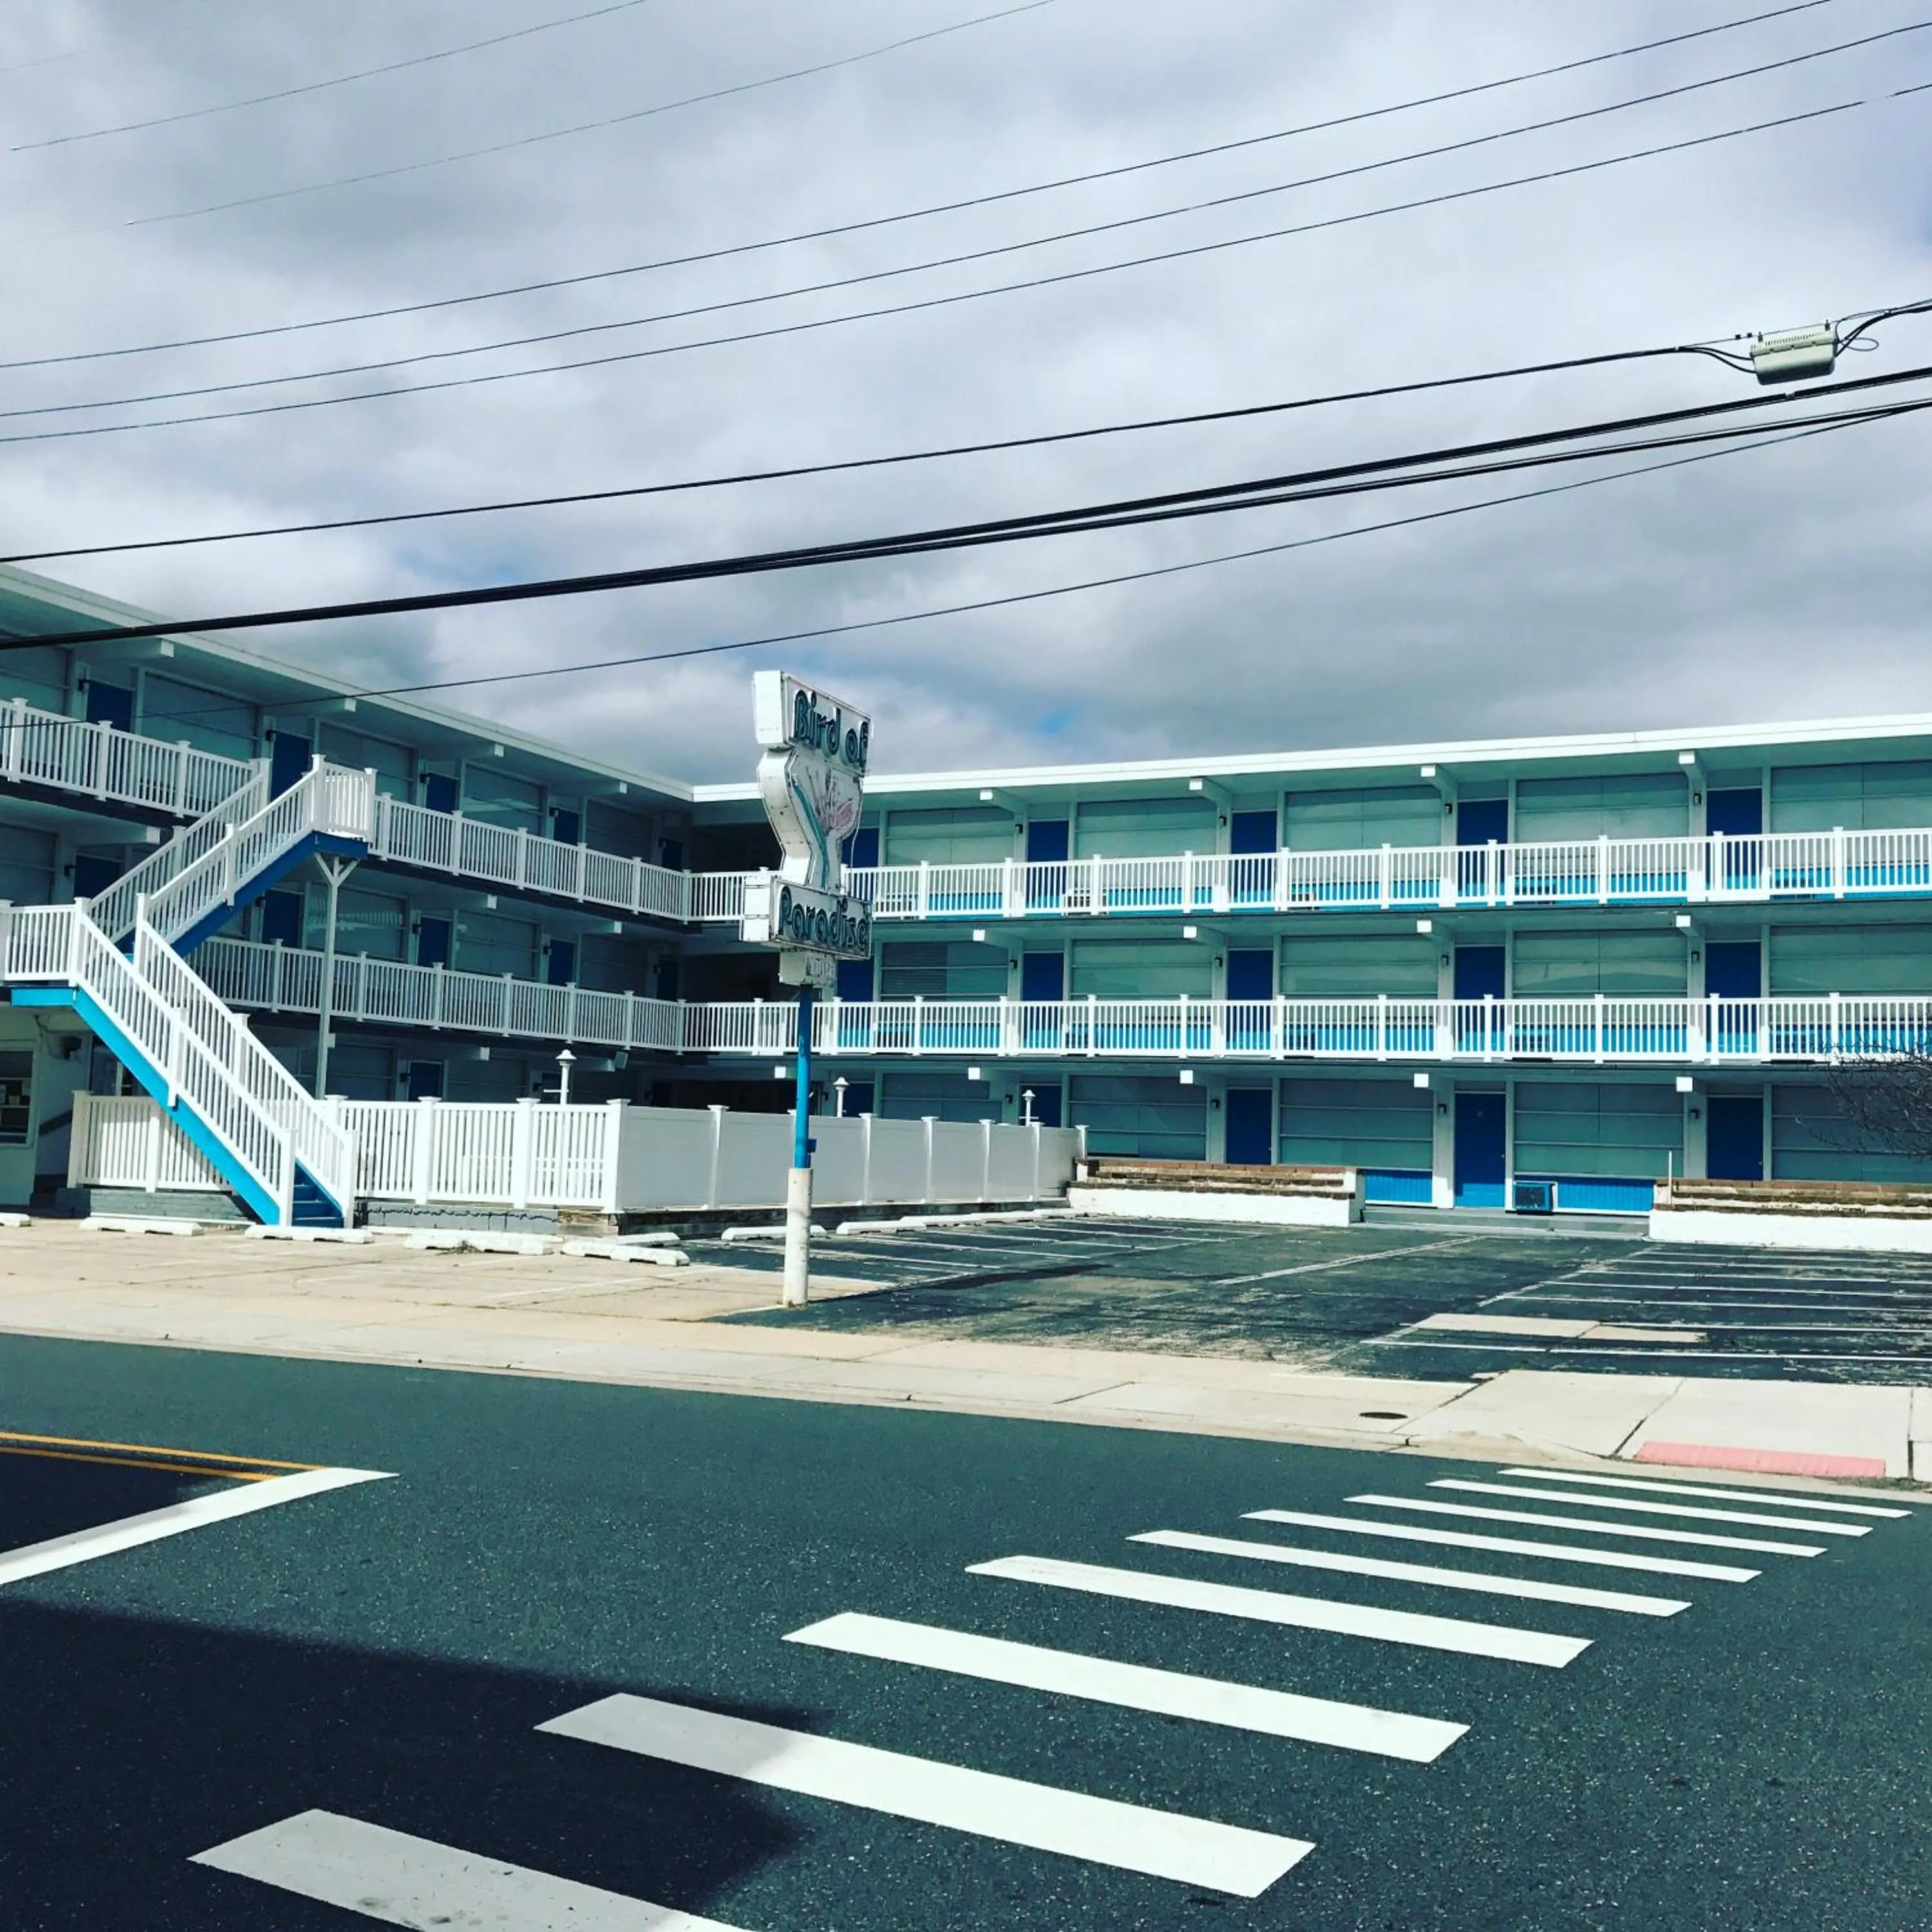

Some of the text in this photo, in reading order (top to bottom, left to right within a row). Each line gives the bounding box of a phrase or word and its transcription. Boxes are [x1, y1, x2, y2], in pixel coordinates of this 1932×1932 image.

[794, 689, 869, 775] Bird of
[778, 886, 868, 951] Paradise
